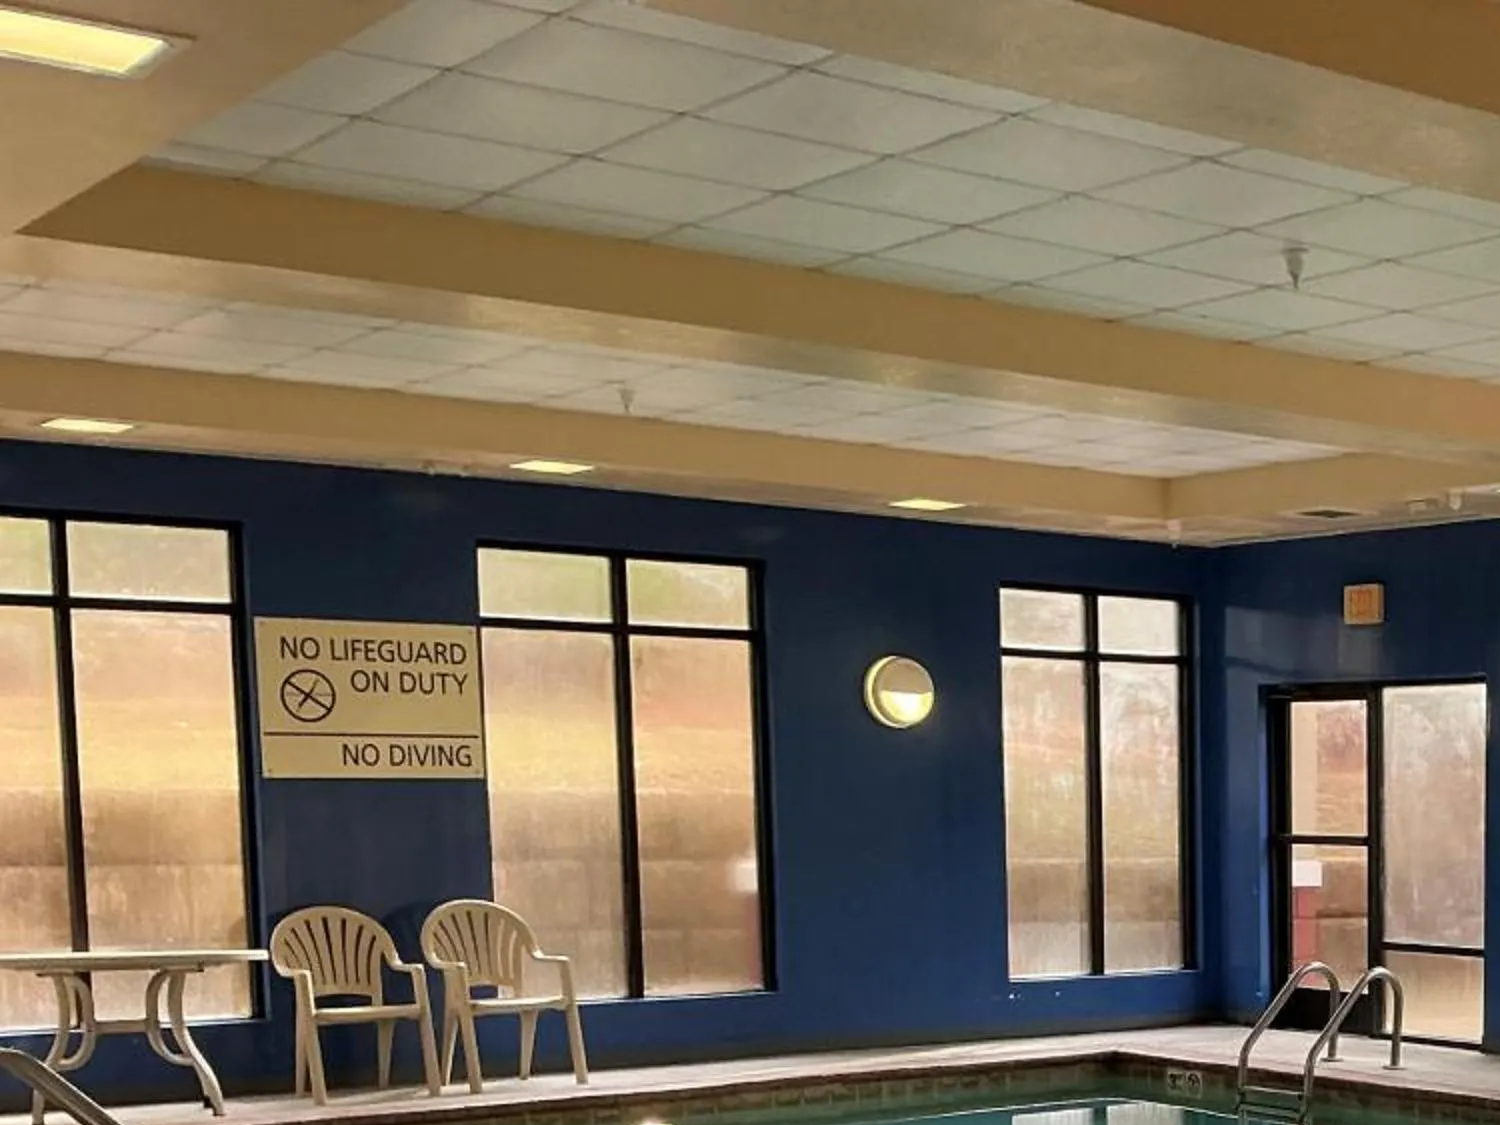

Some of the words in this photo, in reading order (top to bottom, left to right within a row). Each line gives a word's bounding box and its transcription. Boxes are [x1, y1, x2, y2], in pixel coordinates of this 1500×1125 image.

[280, 636, 321, 660] NO
[329, 639, 467, 665] LIFEGUARD
[350, 670, 389, 693] ON
[399, 671, 468, 695] DUTY
[342, 743, 380, 767] NO
[389, 744, 473, 768] DIVING
